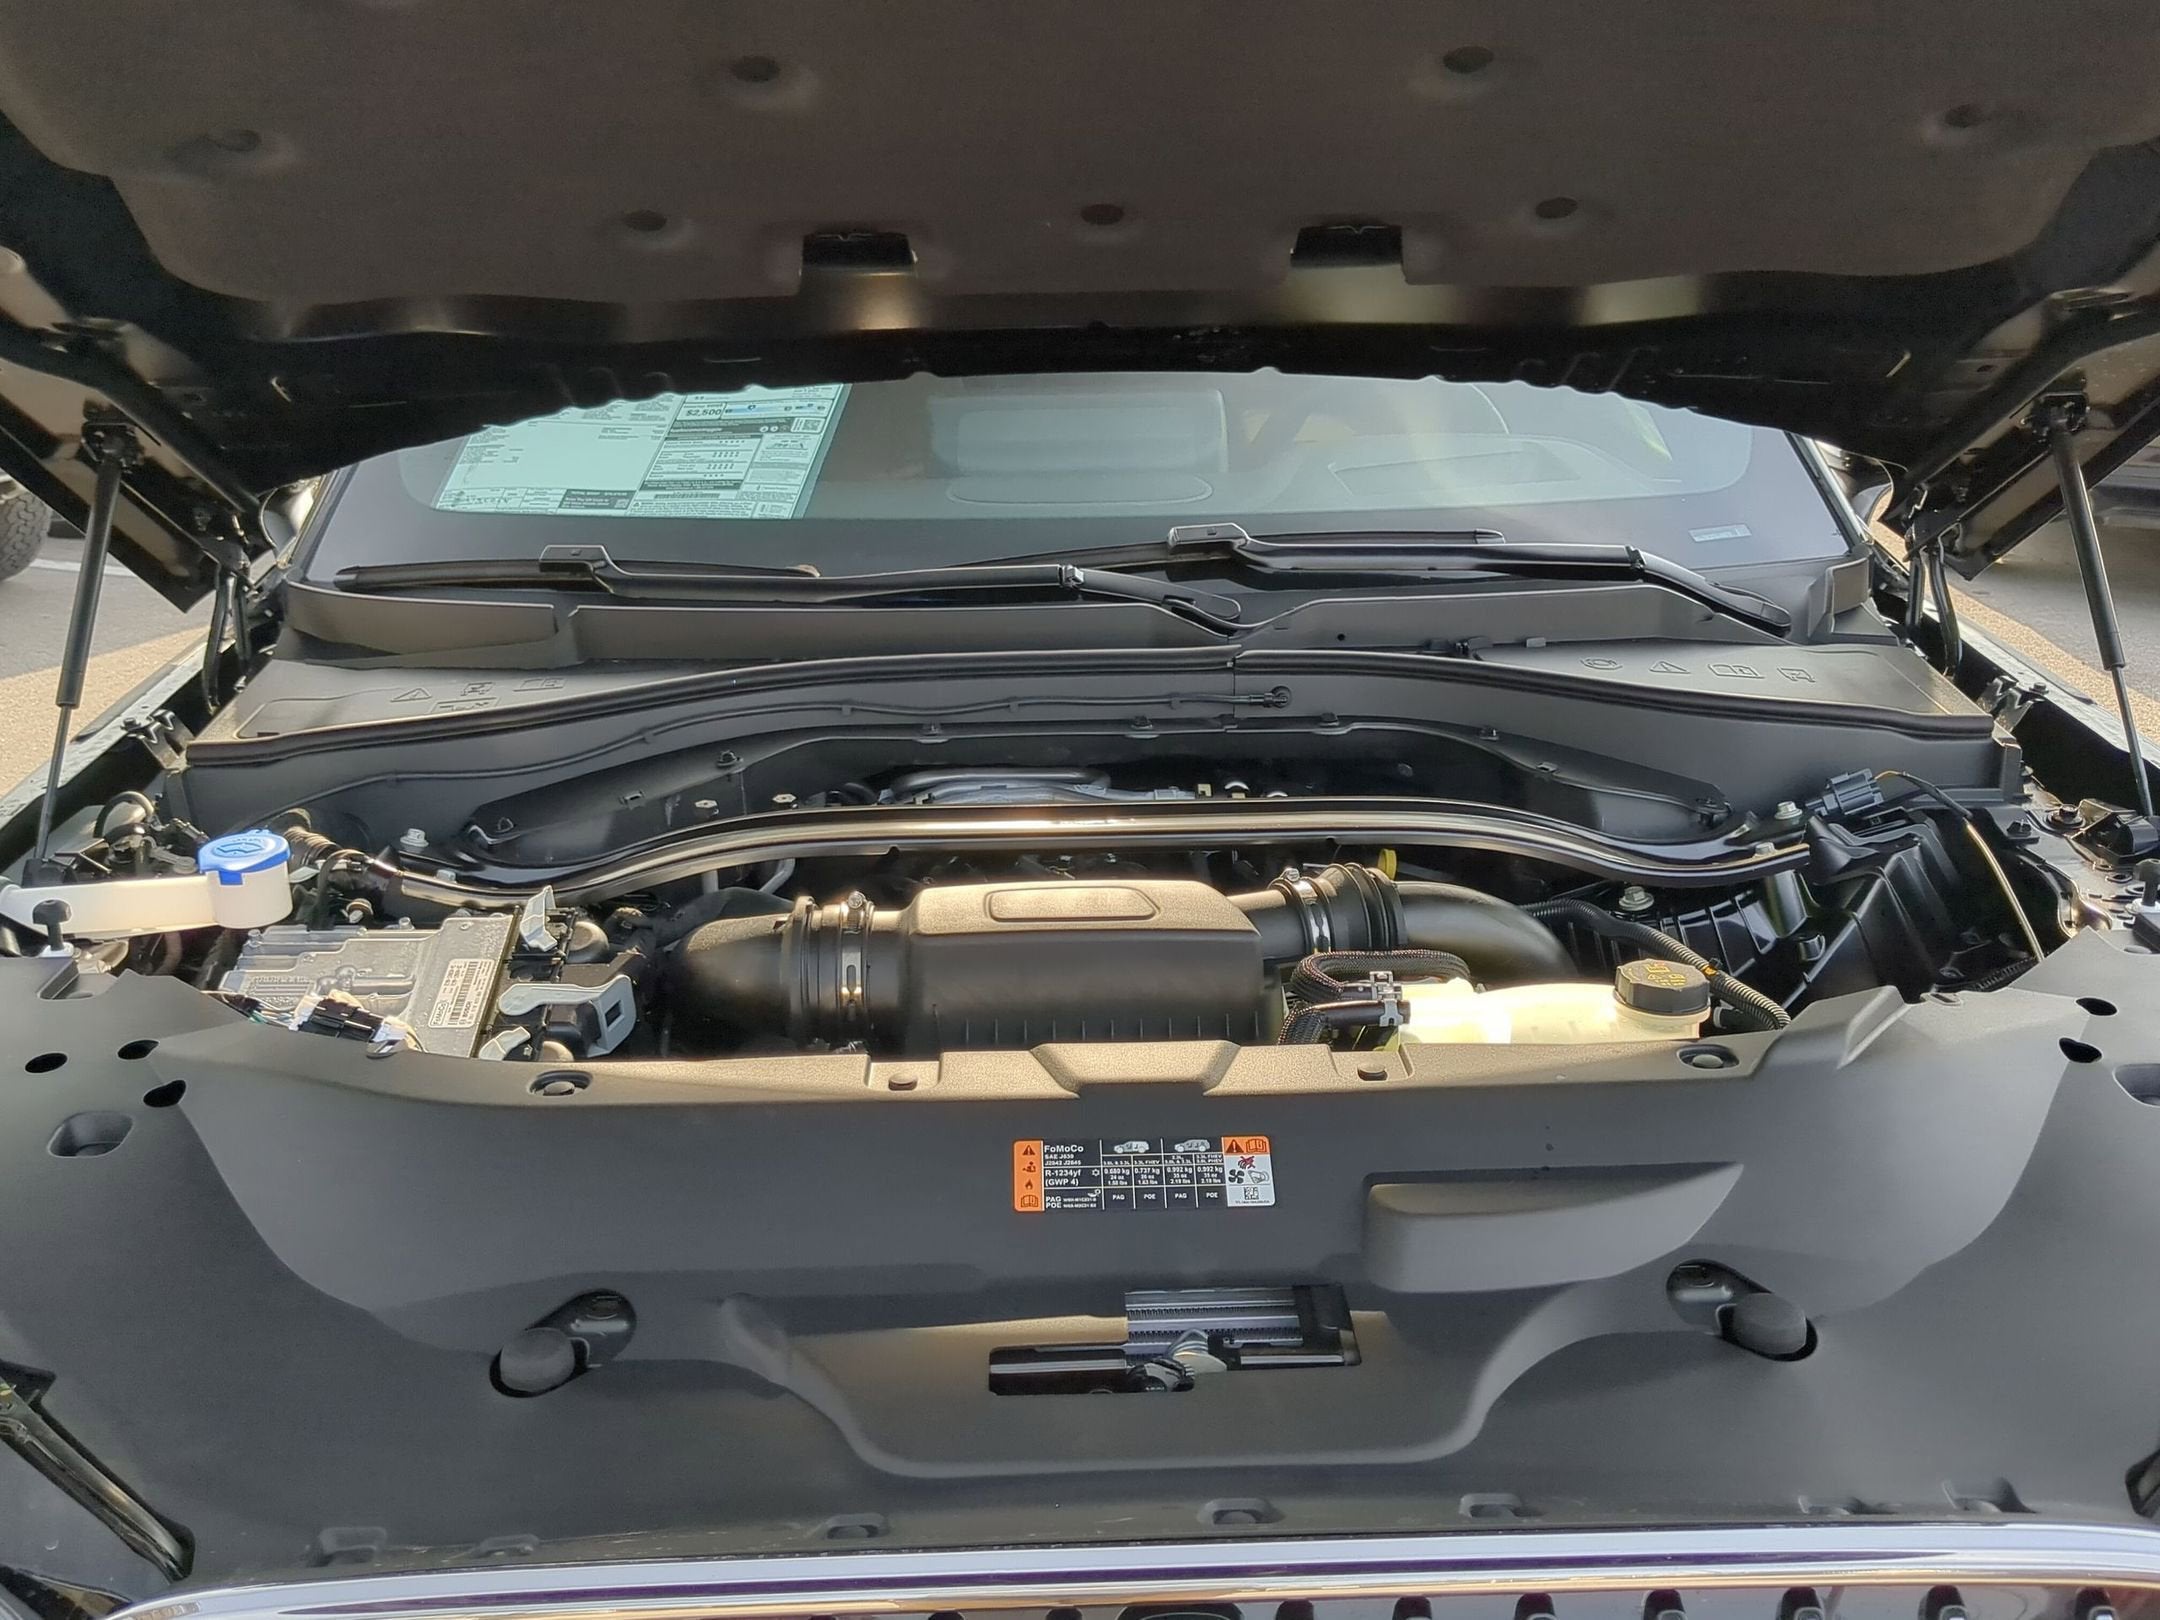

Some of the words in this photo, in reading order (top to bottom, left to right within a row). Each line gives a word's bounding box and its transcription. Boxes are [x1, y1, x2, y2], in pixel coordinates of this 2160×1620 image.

[686, 408, 721, 417] $2,500
[1044, 1144, 1084, 1153] FoMoCo
[1045, 1169, 1081, 1177] R-1234yf
[1184, 1166, 1193, 1174] kg
[1214, 1166, 1223, 1174] kg
[1045, 1179, 1069, 1187] (GWP
[1070, 1178, 1079, 1187] 4)
